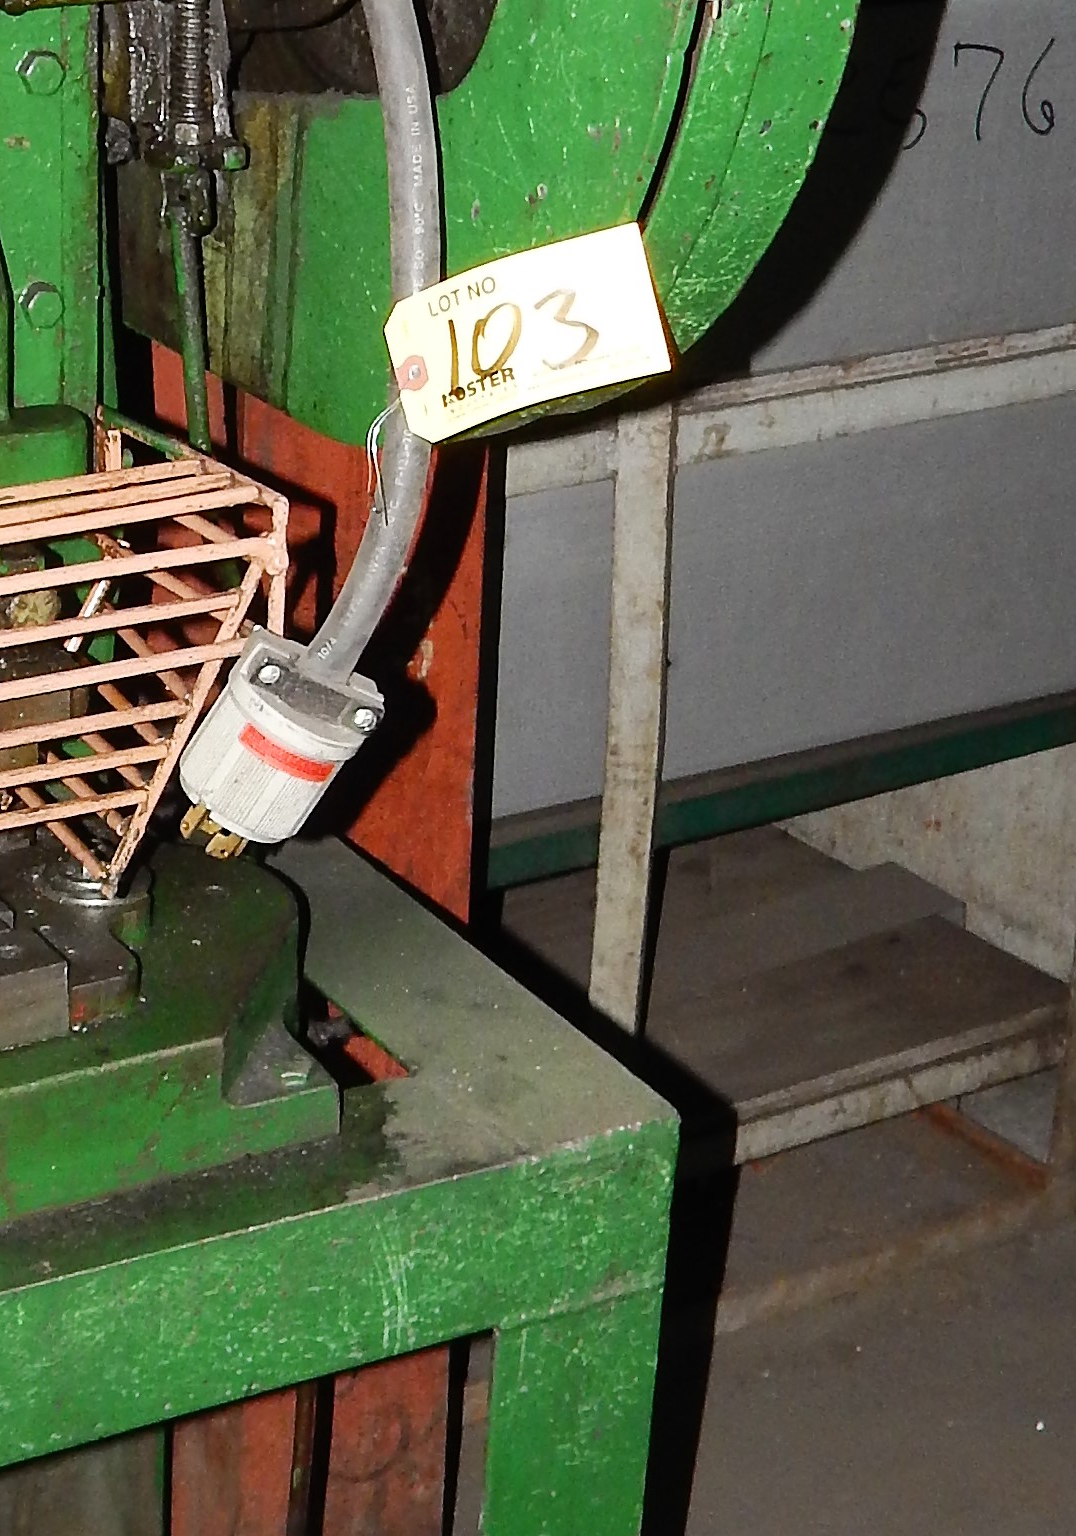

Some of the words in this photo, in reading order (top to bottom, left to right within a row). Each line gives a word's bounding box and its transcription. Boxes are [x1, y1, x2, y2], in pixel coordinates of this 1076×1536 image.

[404, 85, 419, 115] USA
[410, 121, 422, 137] IN
[410, 144, 423, 187] MADE
[427, 288, 461, 317] LOT
[467, 276, 496, 301] NO
[446, 289, 600, 393] 103
